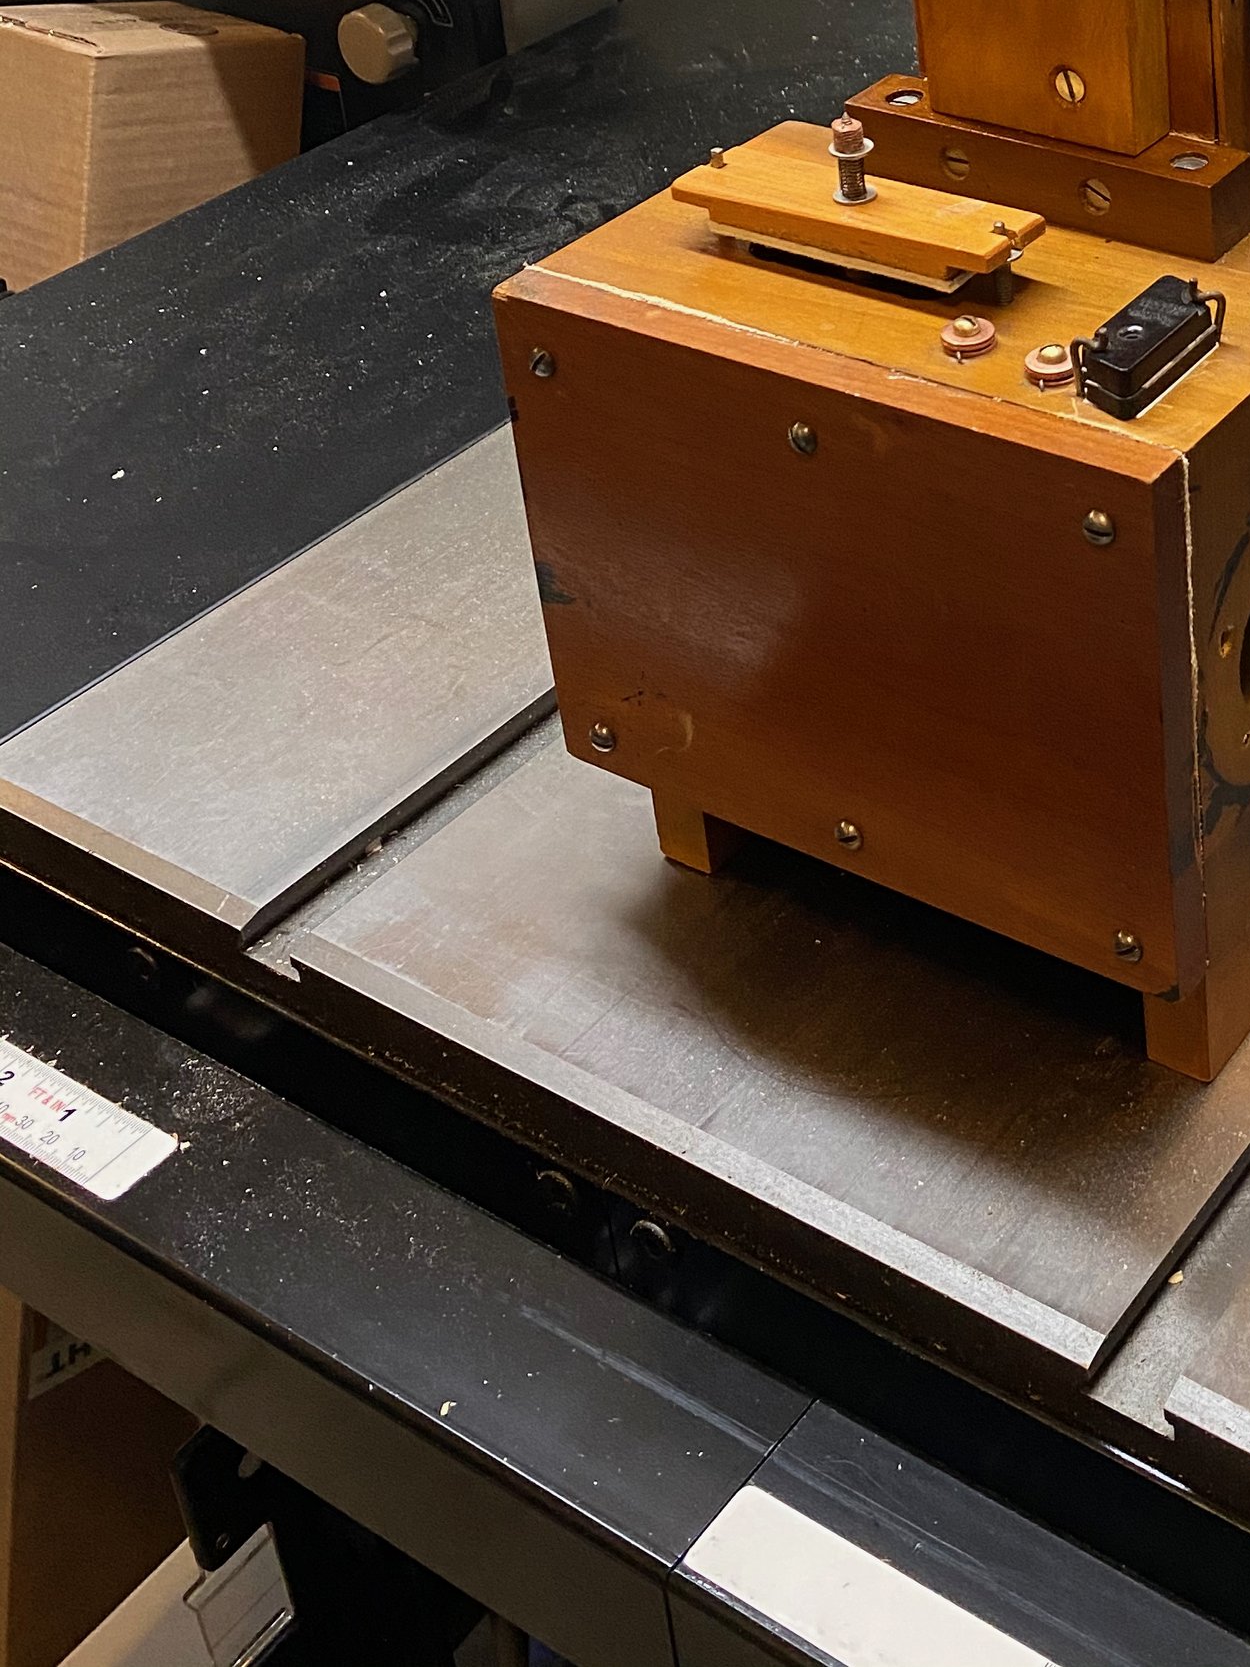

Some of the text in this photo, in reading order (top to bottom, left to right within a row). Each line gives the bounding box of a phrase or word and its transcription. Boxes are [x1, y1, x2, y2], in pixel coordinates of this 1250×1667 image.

[58, 1109, 77, 1122] 1
[15, 1115, 35, 1130] 30
[40, 1130, 60, 1145] 20
[67, 1147, 86, 1161] 10
